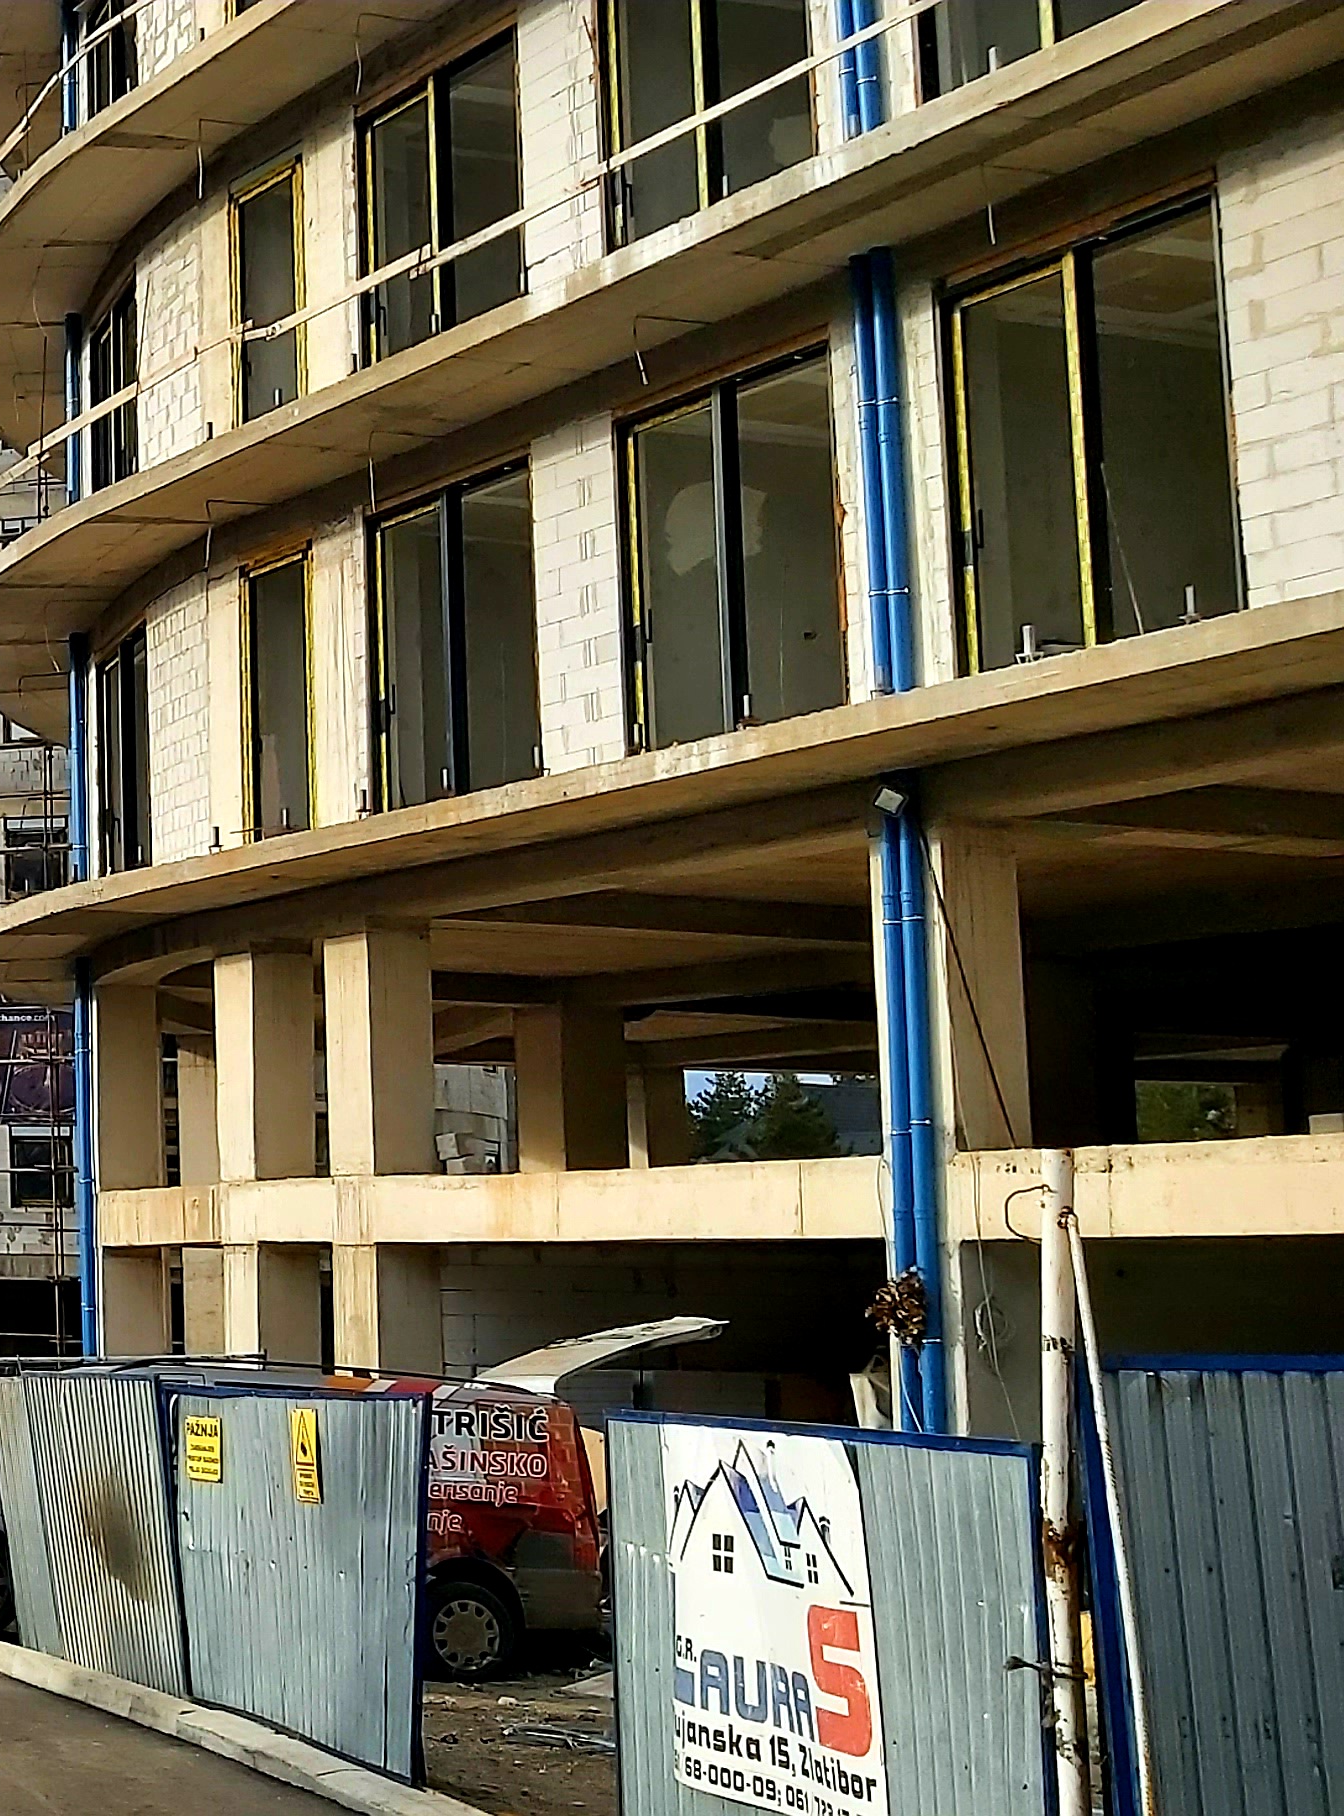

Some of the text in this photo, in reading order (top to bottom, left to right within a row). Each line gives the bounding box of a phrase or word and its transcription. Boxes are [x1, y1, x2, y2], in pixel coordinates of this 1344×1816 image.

[186, 1420, 219, 1438] PAŽNJA
[798, 1742, 877, 1802] Zlatibor
[785, 1784, 810, 1814] 061
